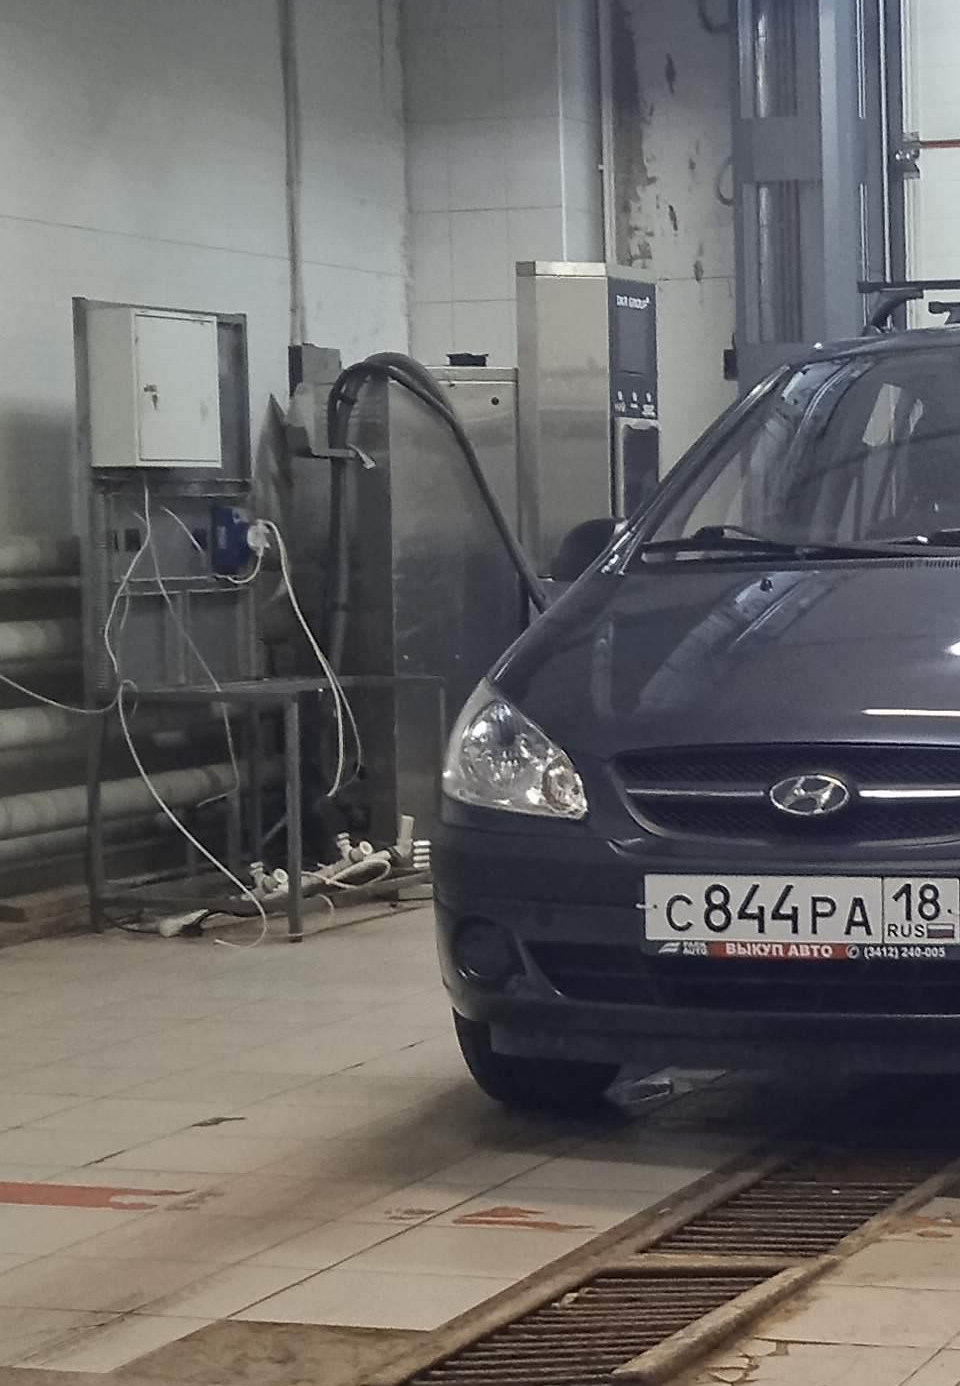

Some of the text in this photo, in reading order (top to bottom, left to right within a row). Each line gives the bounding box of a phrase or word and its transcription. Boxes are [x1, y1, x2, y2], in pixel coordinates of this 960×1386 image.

[665, 882, 941, 936] С844РА 18
[886, 923, 925, 938] RUS
[725, 942, 833, 958] ВЫКУП АВТО
[863, 946, 946, 959] (3412) 240-005
